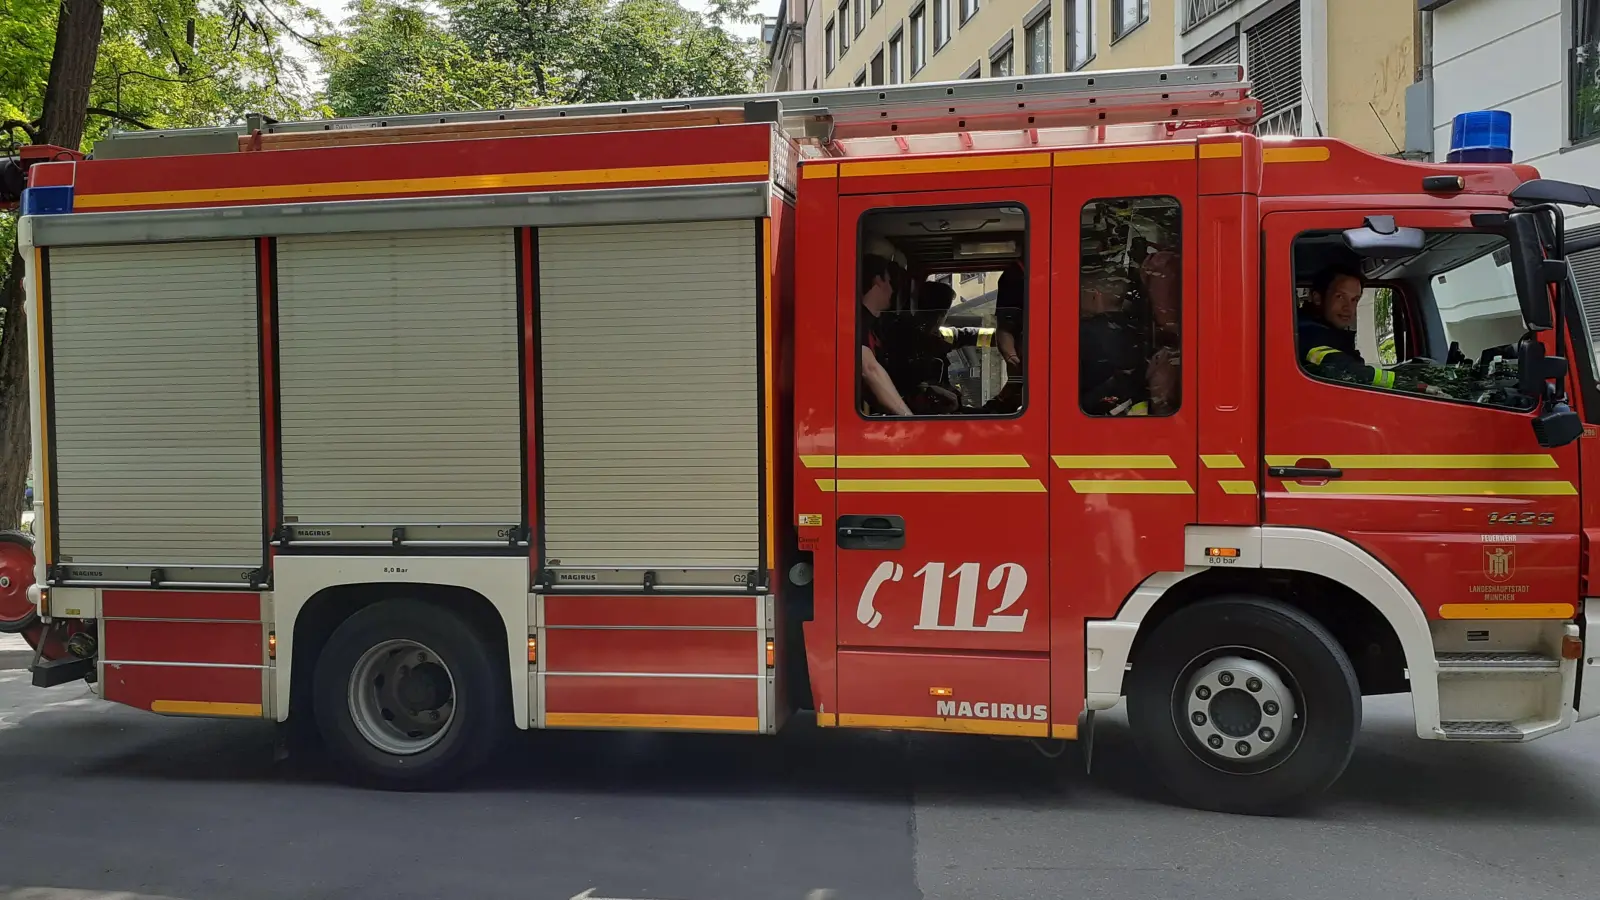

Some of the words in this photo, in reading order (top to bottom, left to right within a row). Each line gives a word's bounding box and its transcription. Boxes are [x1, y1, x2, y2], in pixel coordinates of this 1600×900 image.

[497, 529, 510, 538] G4
[1481, 534, 1517, 542] FEUERWEHR
[1222, 556, 1237, 564] bar
[733, 574, 747, 583] G2
[1469, 585, 1530, 593] LANDESHAUPTSTADT
[913, 562, 1029, 632] 112
[936, 700, 1048, 720] MAGIRUS
